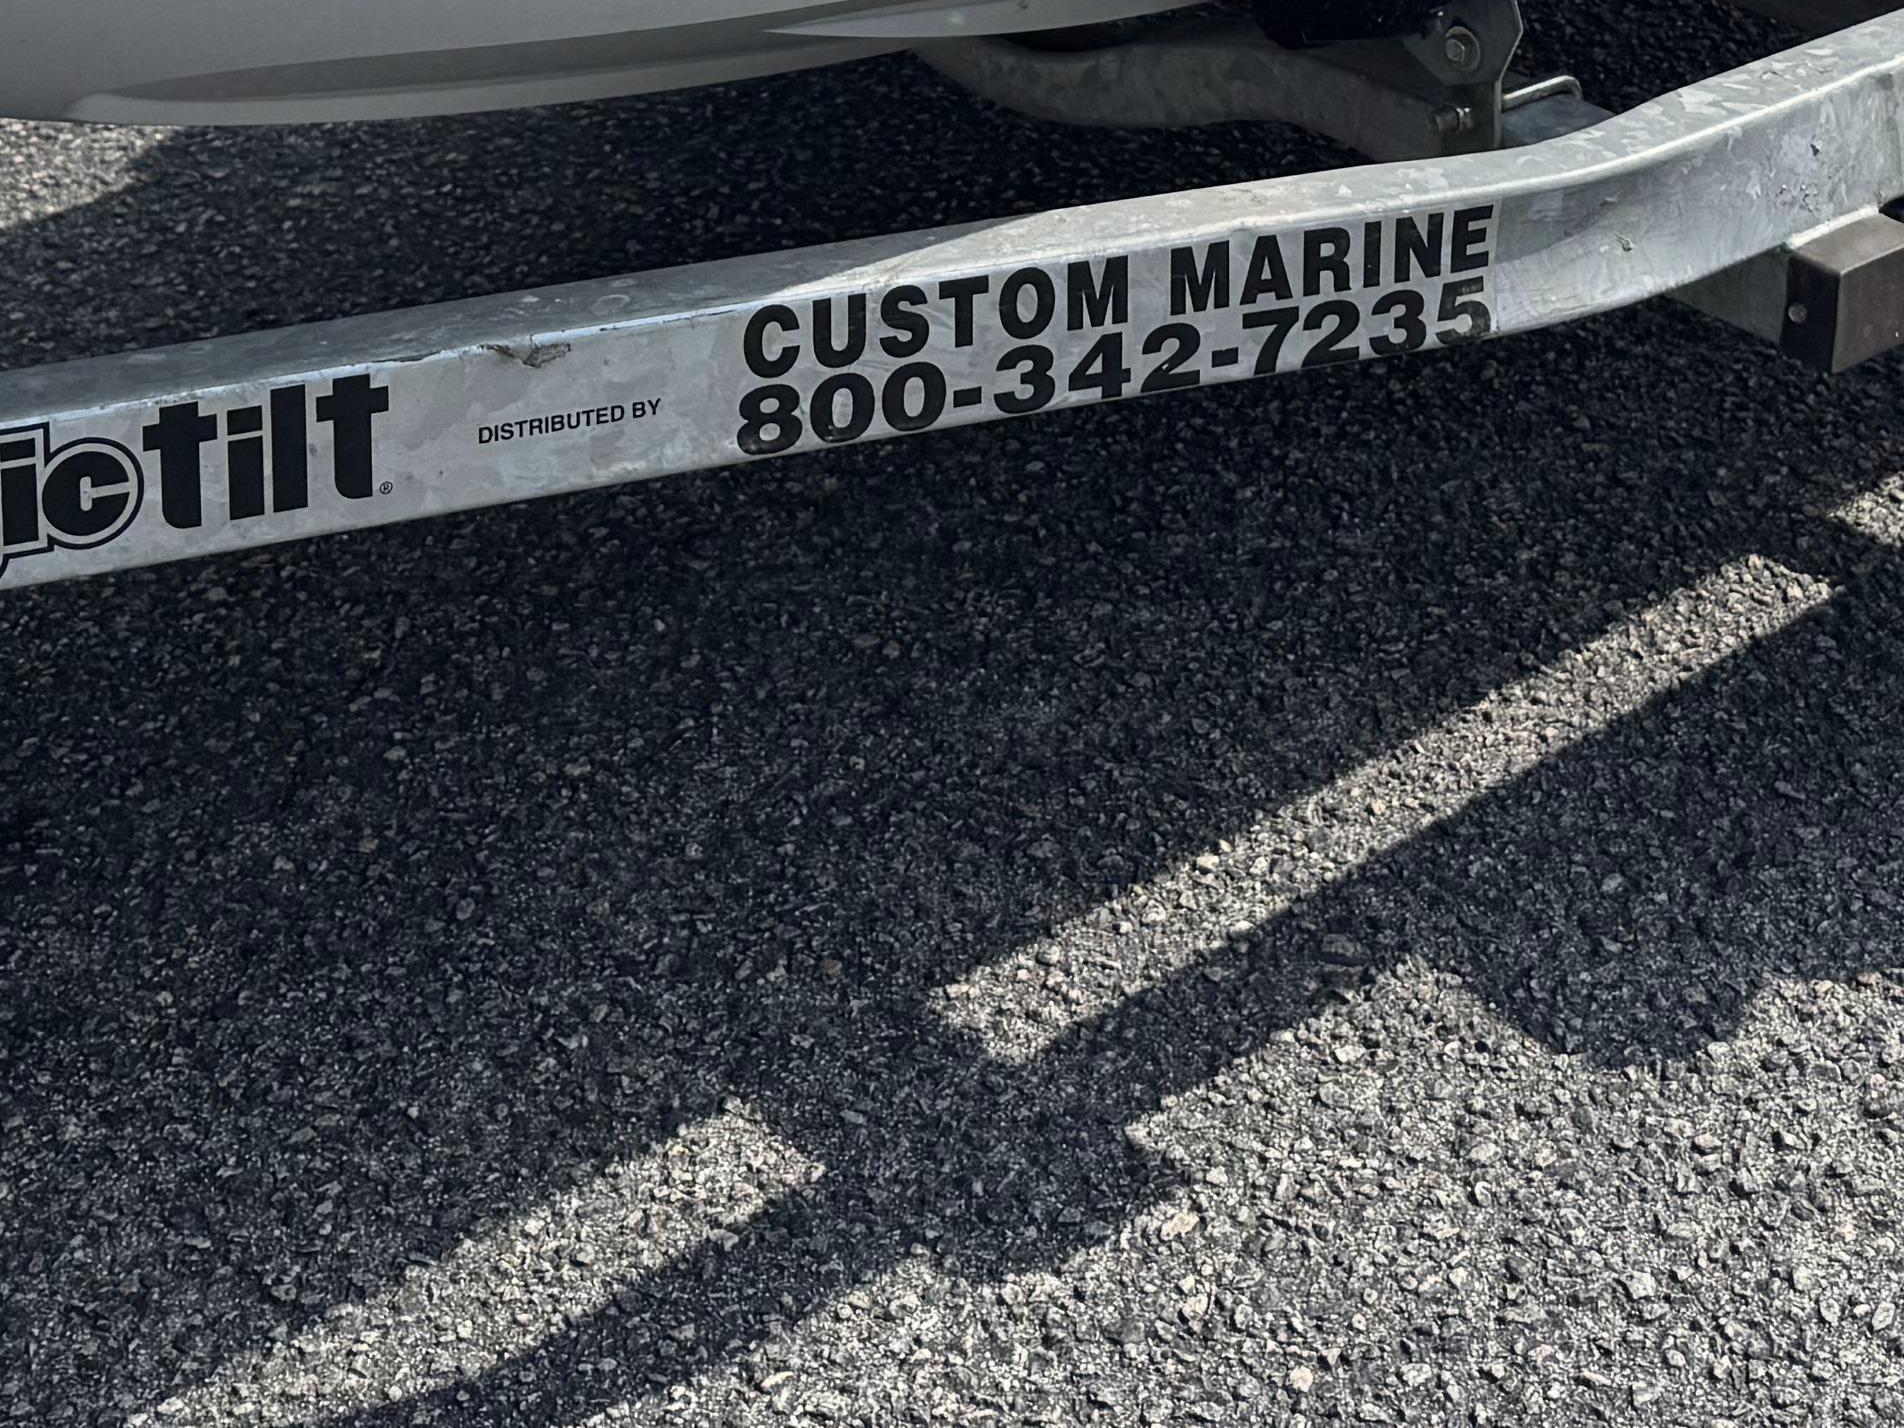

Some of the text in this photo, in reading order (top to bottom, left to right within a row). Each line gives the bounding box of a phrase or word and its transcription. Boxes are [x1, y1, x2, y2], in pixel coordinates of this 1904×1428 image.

[736, 275, 1491, 455] 800-342-7235
[743, 205, 1494, 379] CUSTOM MARINE
[478, 398, 662, 444] DISTRIBUTED BY
